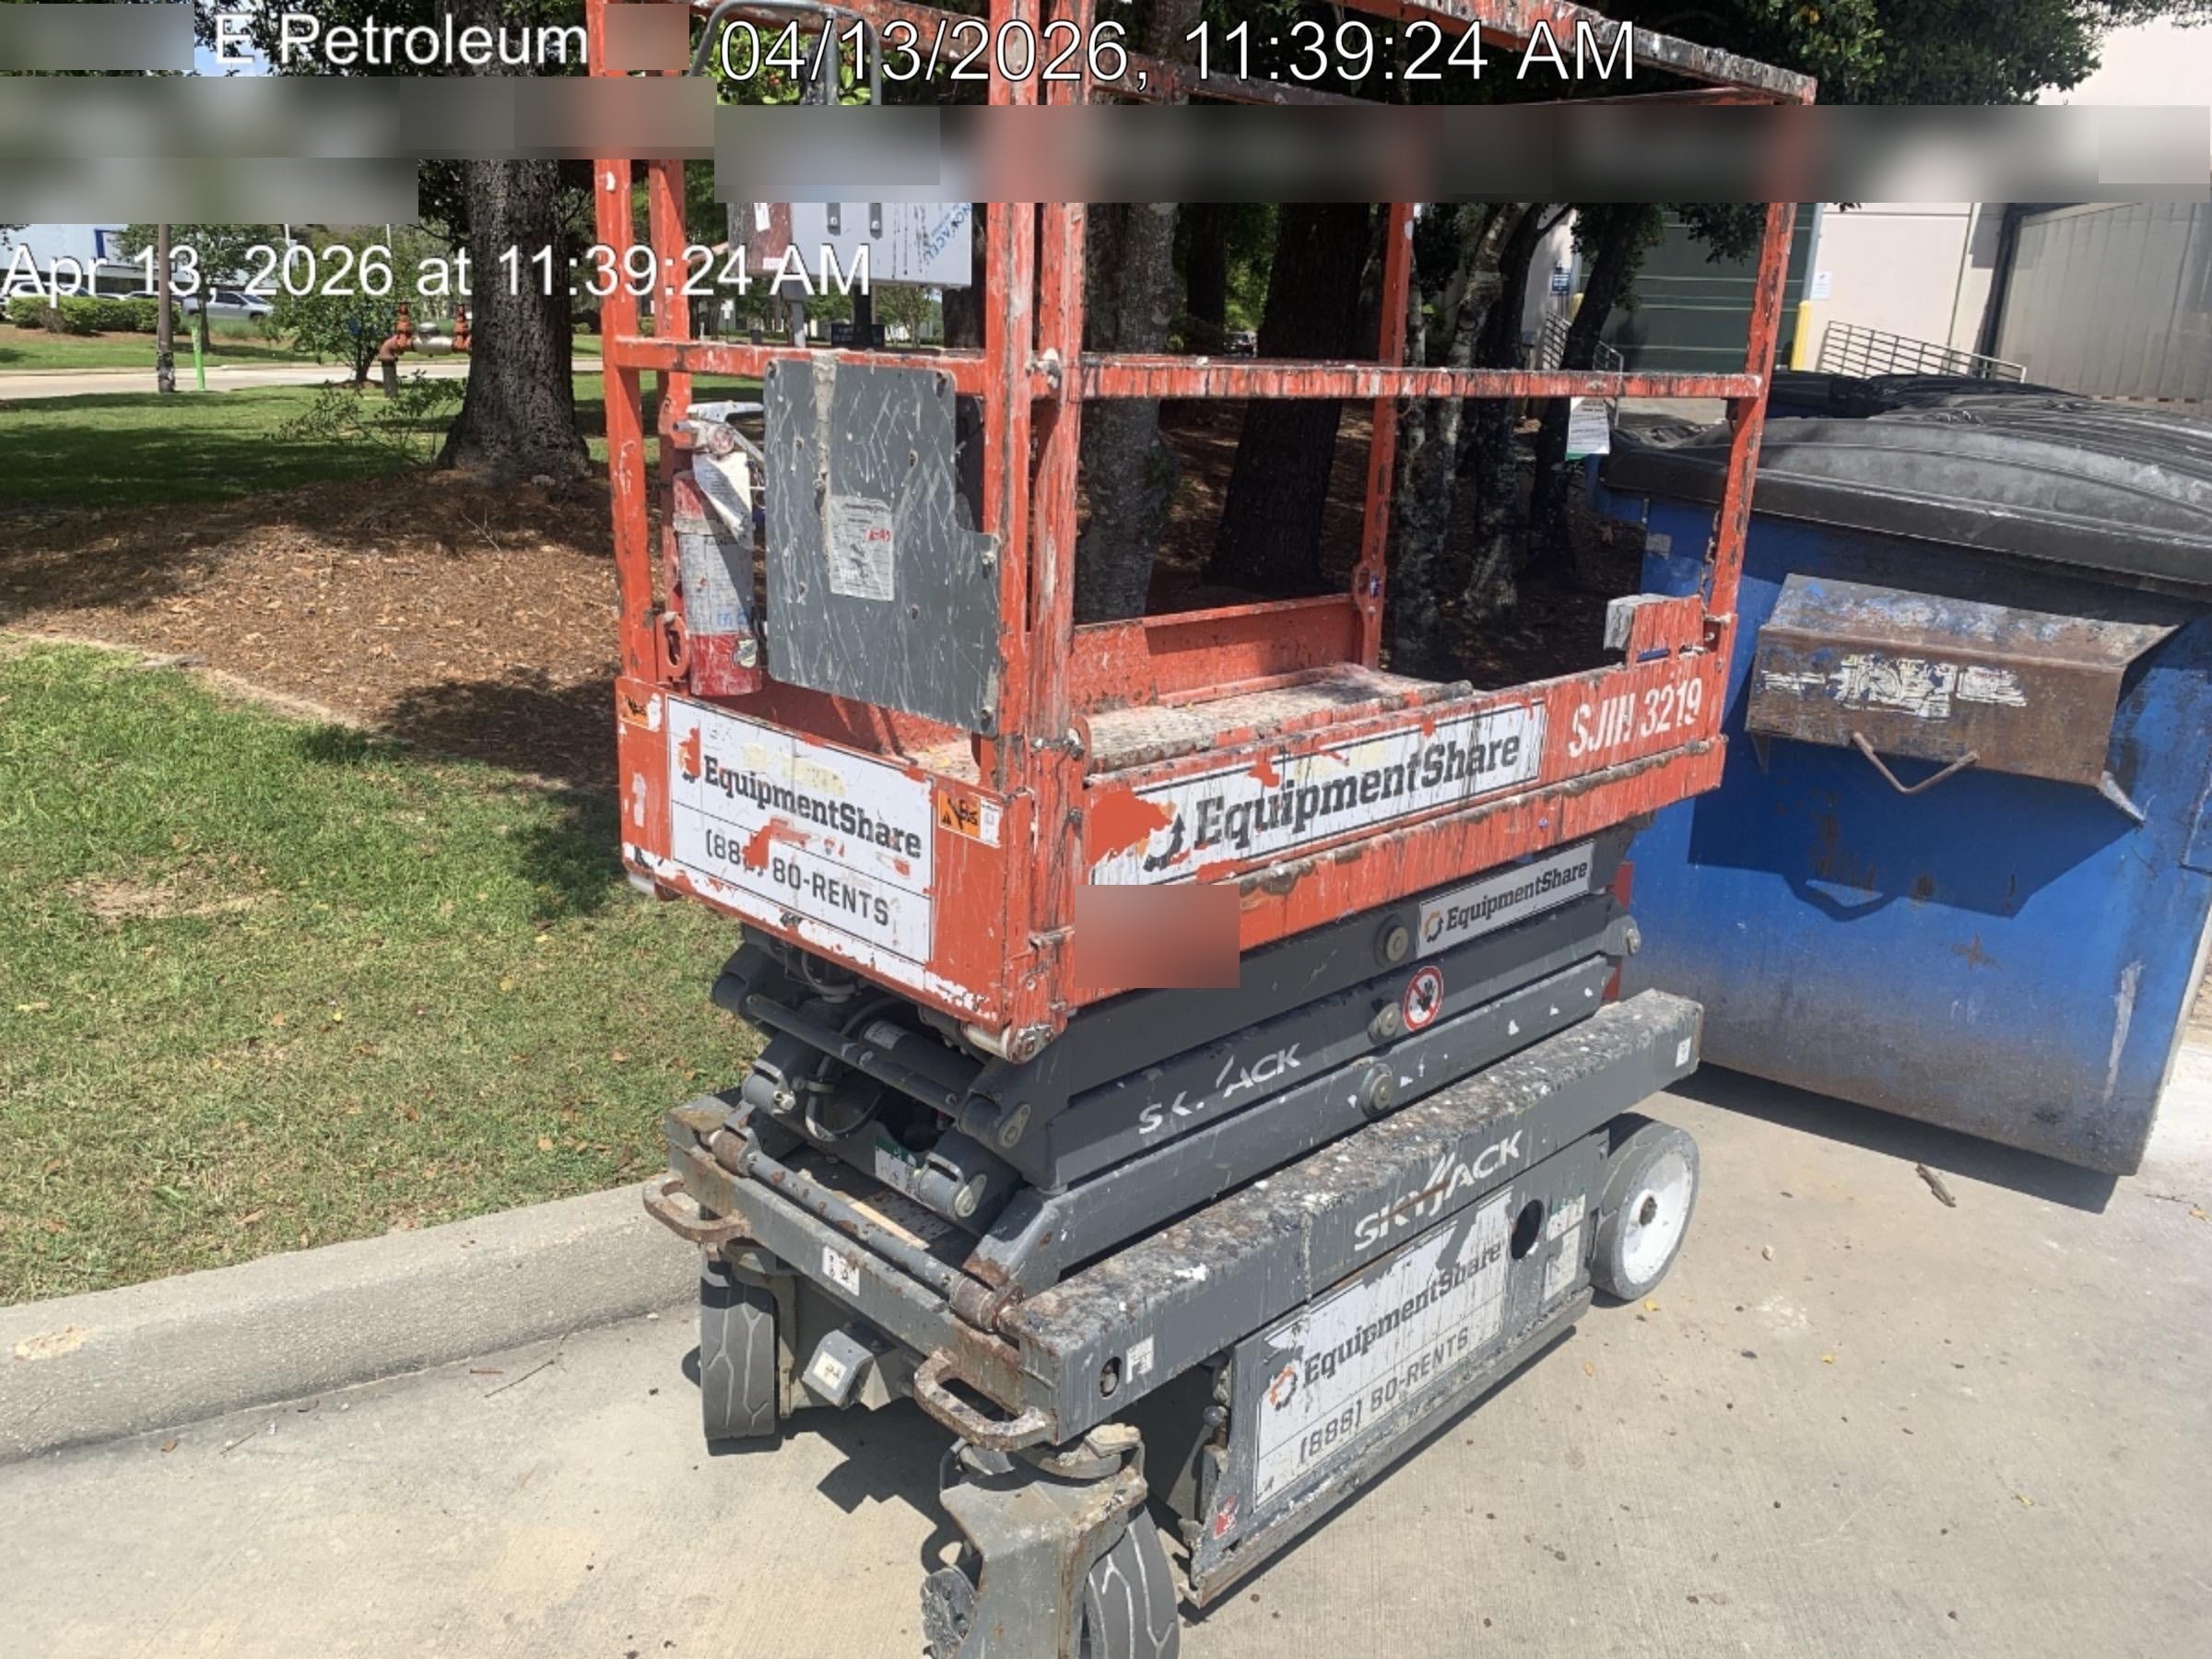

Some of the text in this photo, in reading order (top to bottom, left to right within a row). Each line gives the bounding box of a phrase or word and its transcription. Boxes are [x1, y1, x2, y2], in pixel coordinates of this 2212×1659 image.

[1640, 677, 1702, 738] 3219
[703, 755, 922, 859] EquipmentShare
[1194, 734, 1521, 851] EquipmentShare
[771, 856, 889, 927] 80-RENTS
[1445, 861, 1589, 931] EquipmentShare
[1354, 1129, 1524, 1253] SKYJACK
[1302, 1242, 1502, 1389] EquipmentShare
[1300, 1325, 1470, 1464] (888) 80-RENTS
